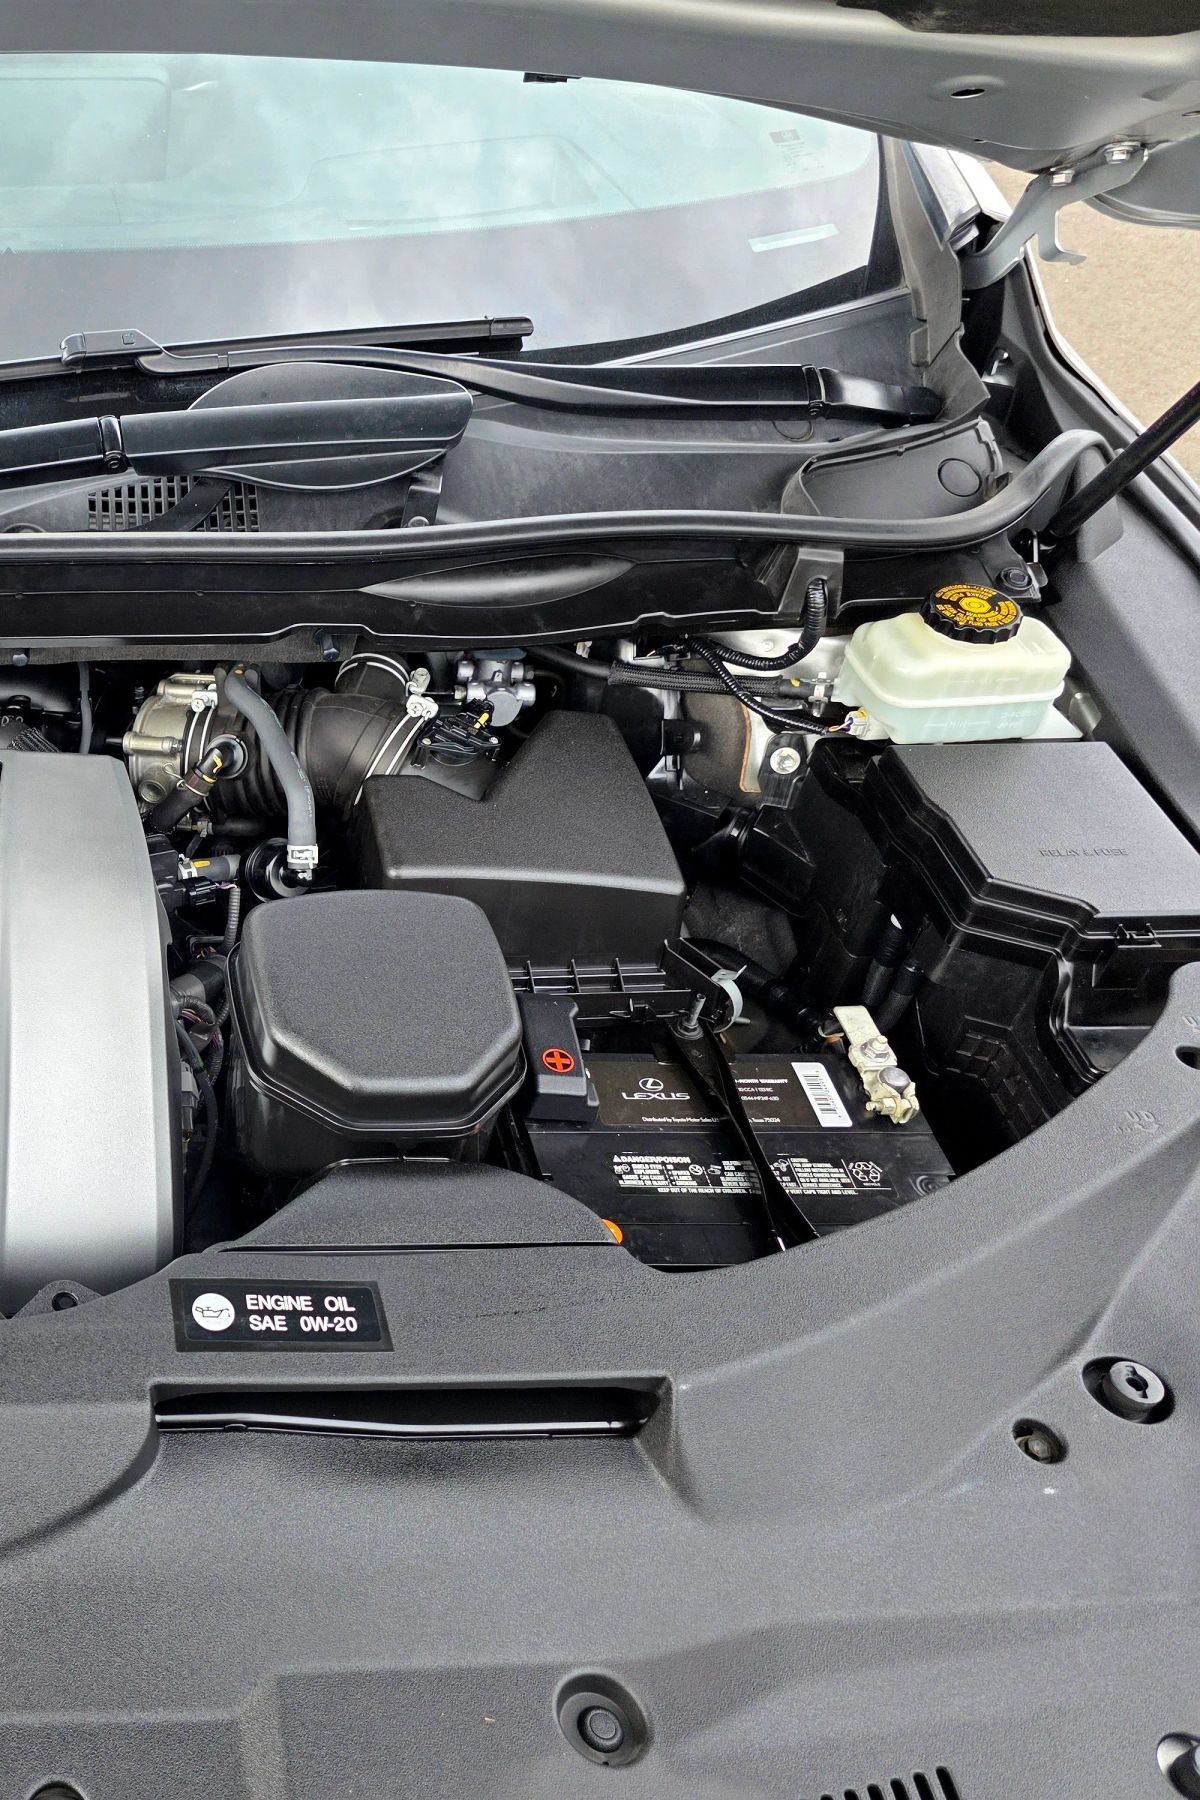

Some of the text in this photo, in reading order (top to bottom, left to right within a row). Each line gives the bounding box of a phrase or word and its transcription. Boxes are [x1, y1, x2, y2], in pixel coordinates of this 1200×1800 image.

[1038, 848, 1080, 857] RELAY
[1094, 848, 1129, 857] FUSE
[621, 1092, 691, 1100] LEXUS
[245, 1294, 356, 1312] ENGINE OIL
[248, 1314, 358, 1332] SAE 0W-20
